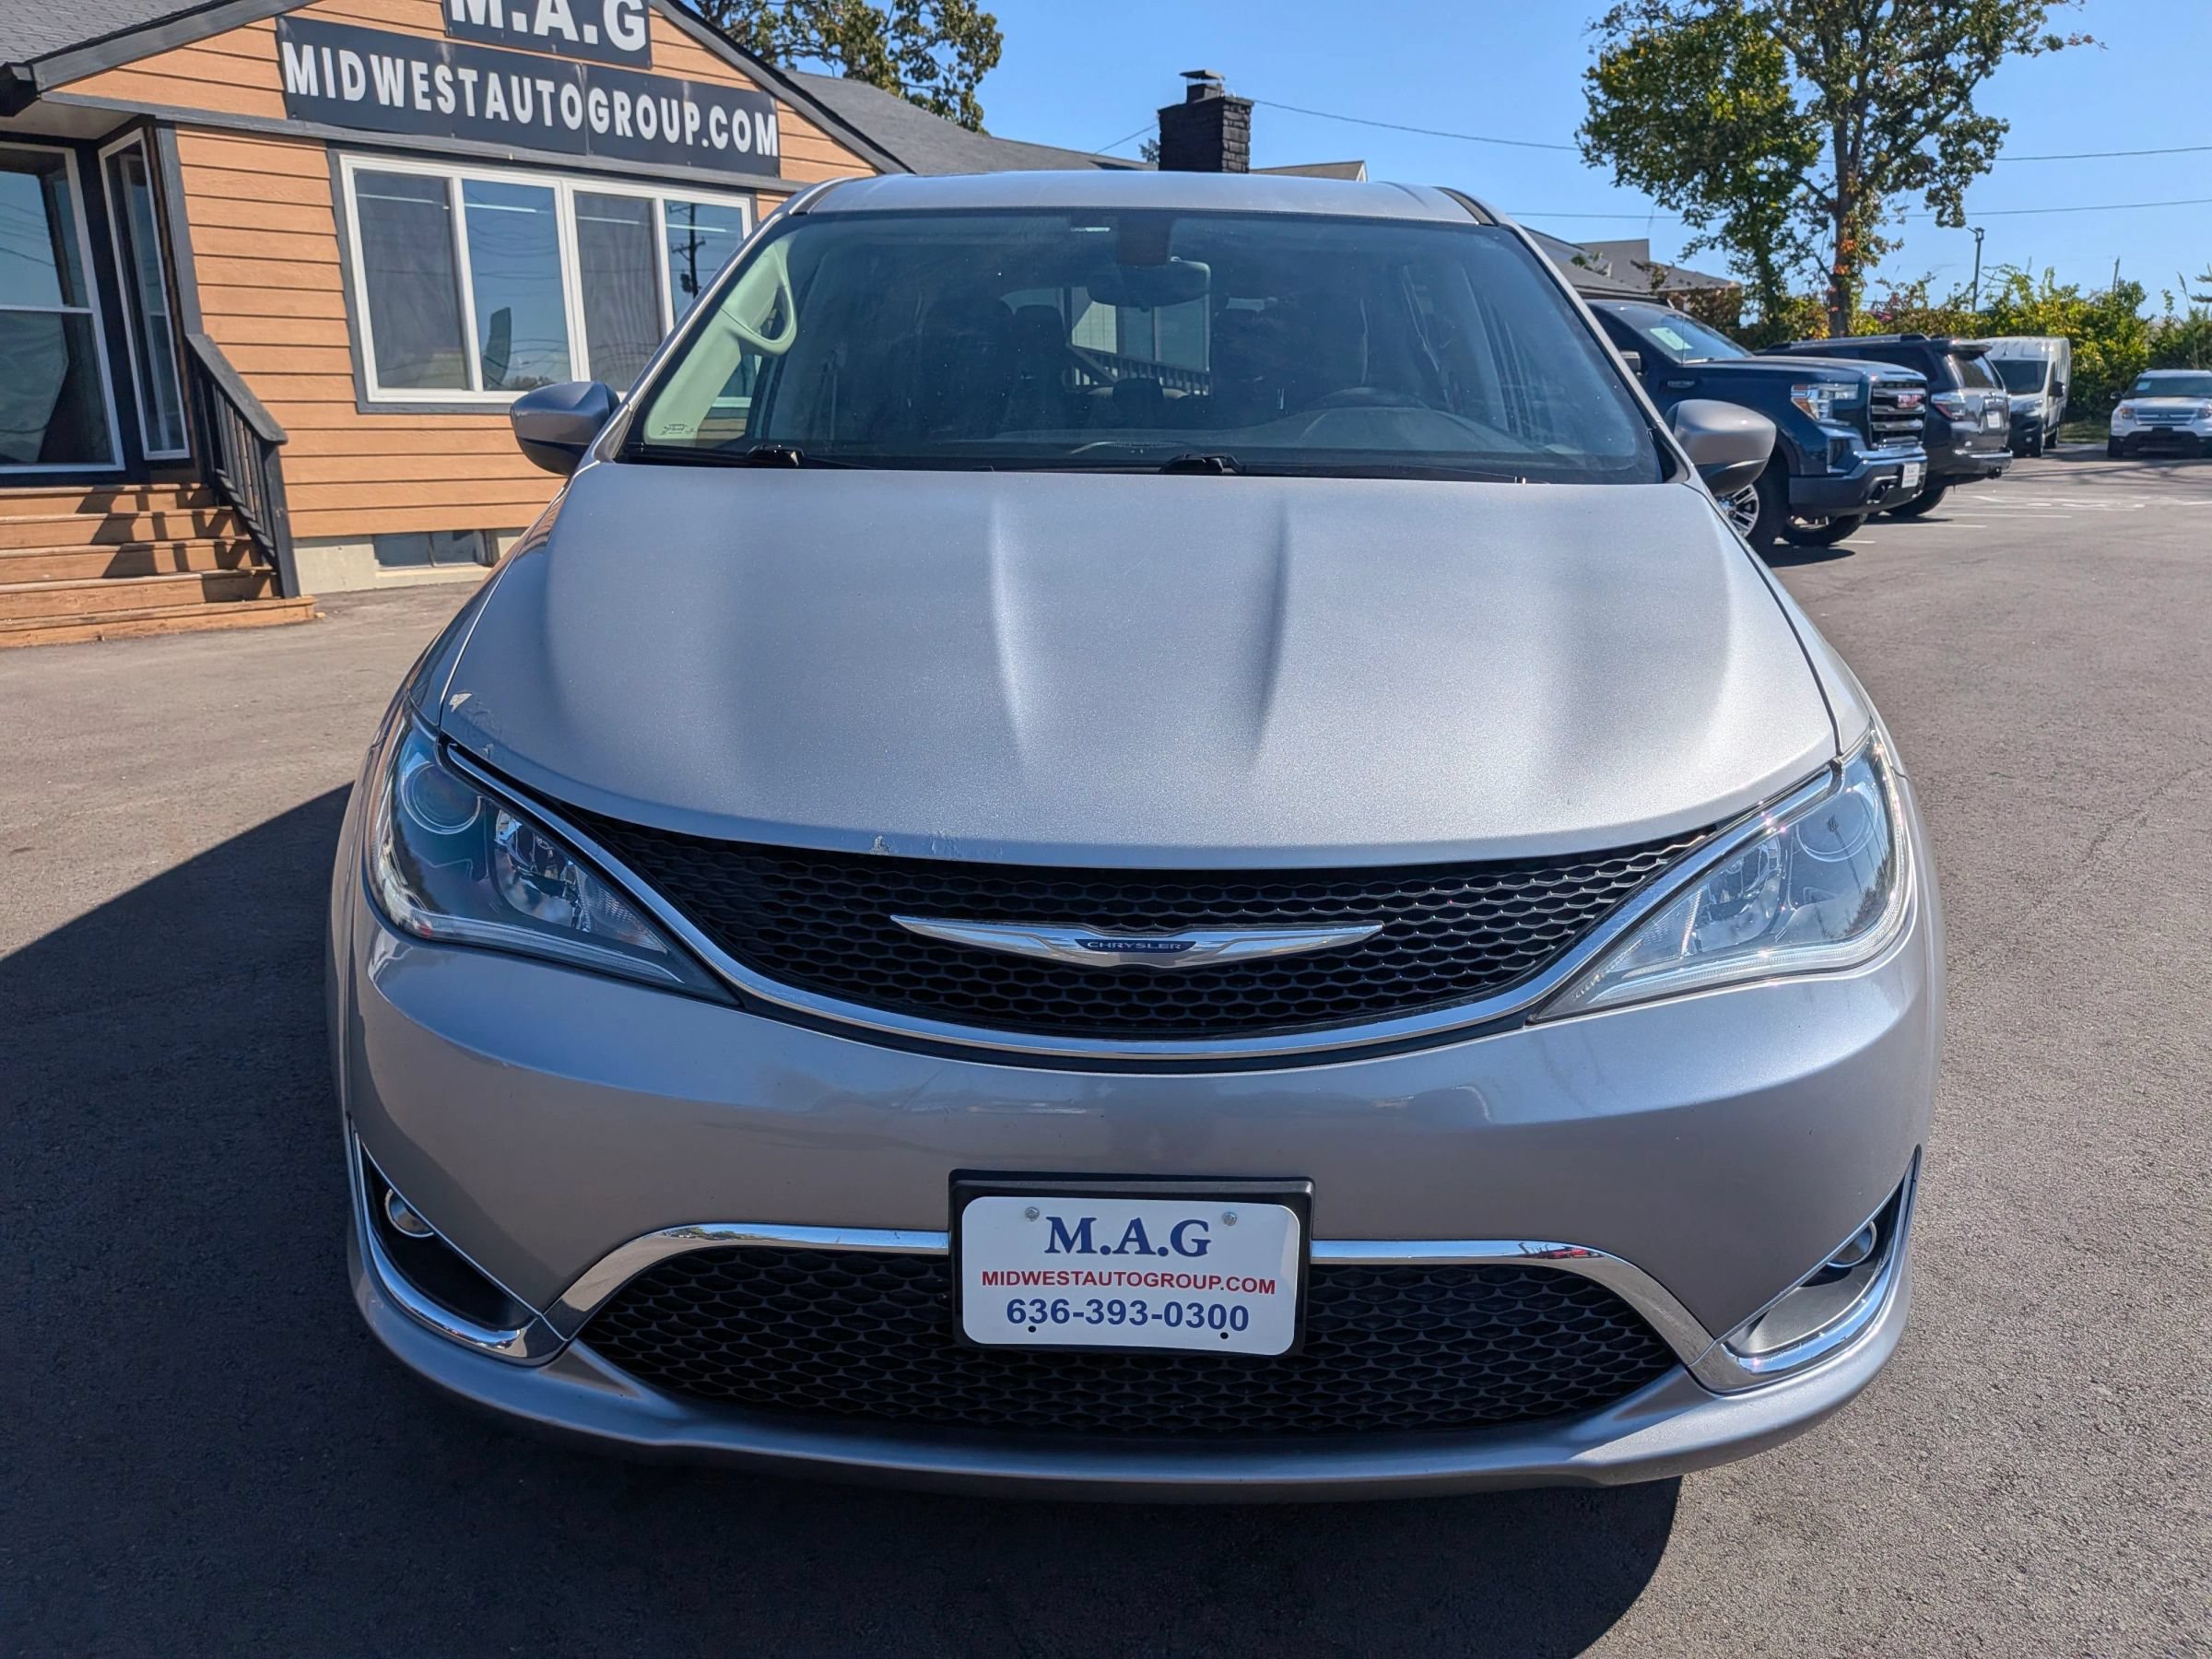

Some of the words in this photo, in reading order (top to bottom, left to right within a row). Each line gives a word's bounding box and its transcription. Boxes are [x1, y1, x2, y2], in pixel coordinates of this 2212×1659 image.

[282, 41, 778, 157] MIDWESTAUTOGROUP.COM
[1088, 941, 1182, 950] CHRYSLER
[1044, 1216, 1211, 1257] M.A.G
[982, 1270, 1276, 1295] MIDWESTAUTOGROUP.COM
[1006, 1299, 1249, 1332] 636-393-0300
